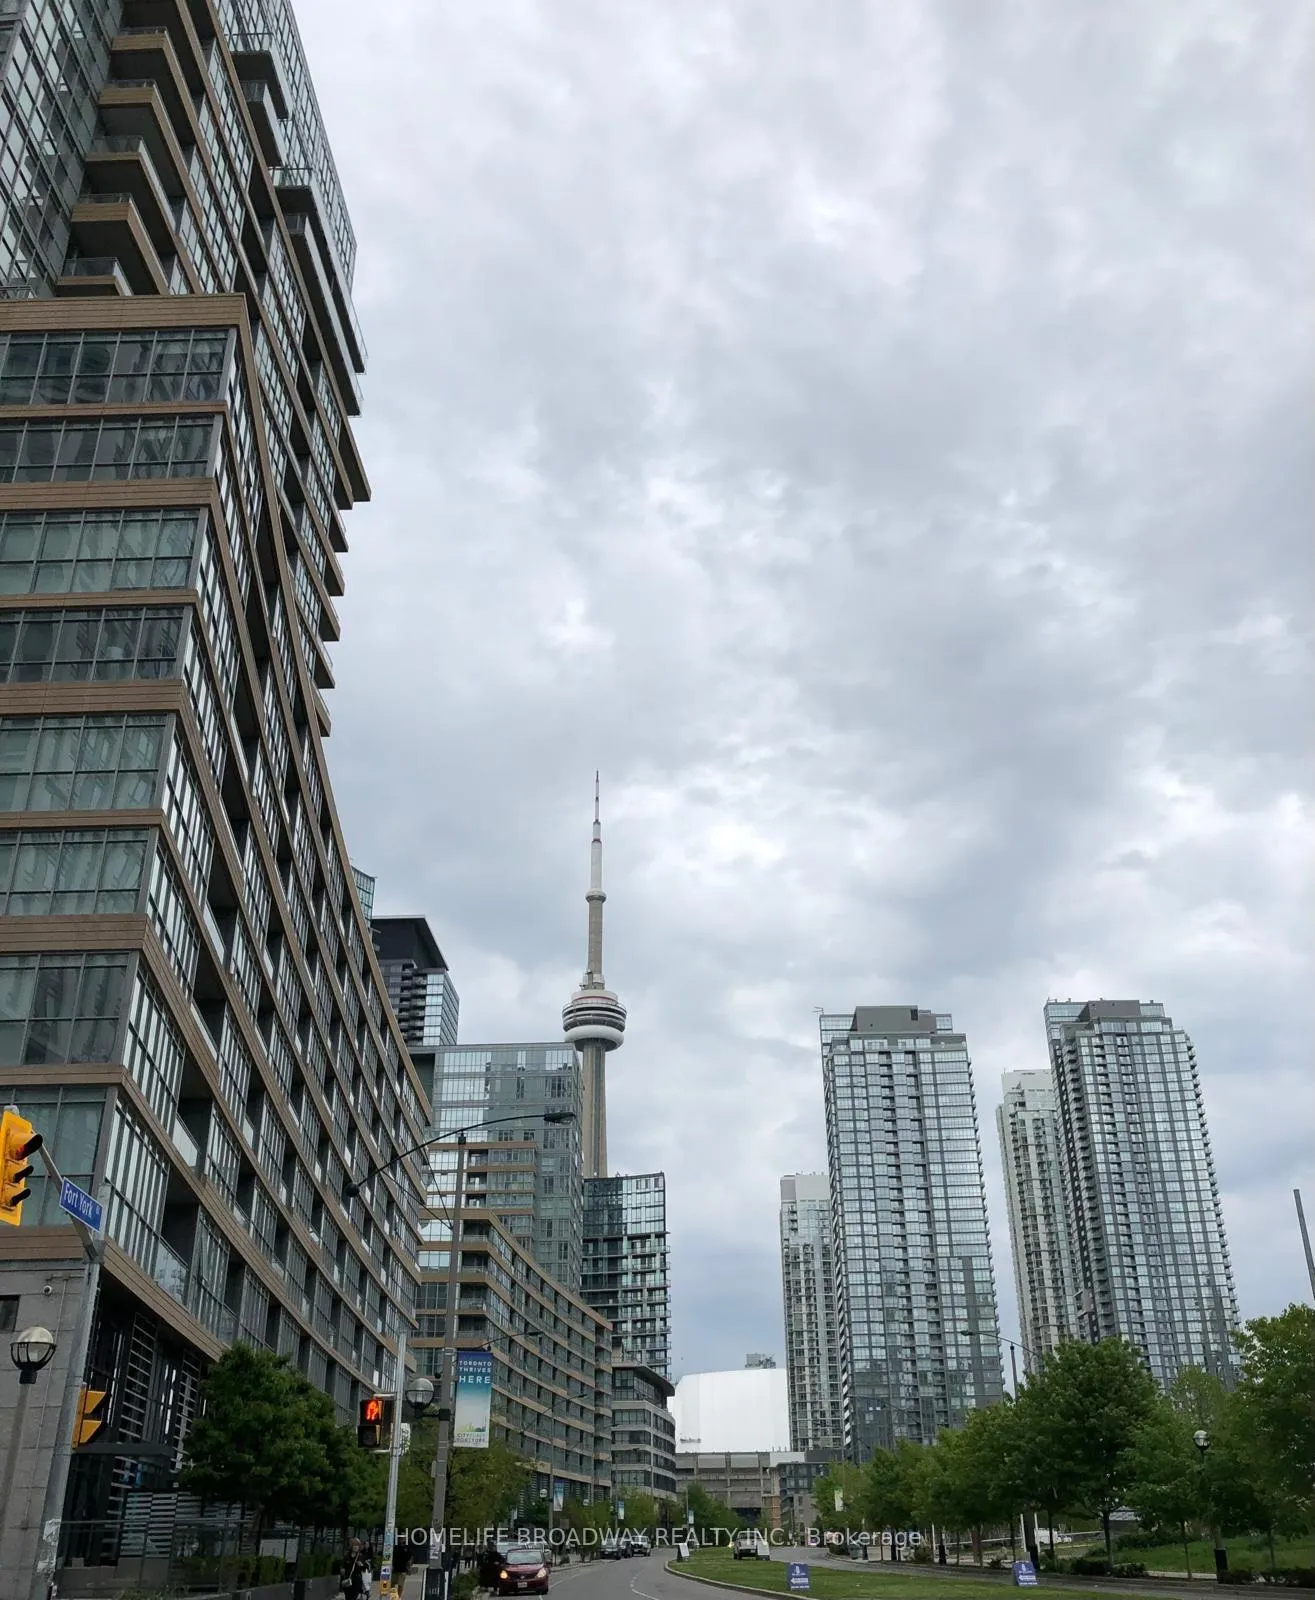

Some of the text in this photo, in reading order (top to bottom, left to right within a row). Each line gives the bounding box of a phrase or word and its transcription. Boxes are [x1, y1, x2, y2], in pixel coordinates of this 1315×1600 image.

[64, 1182, 78, 1208] Fort
[79, 1192, 94, 1218] York
[458, 1375, 491, 1384] HERE
